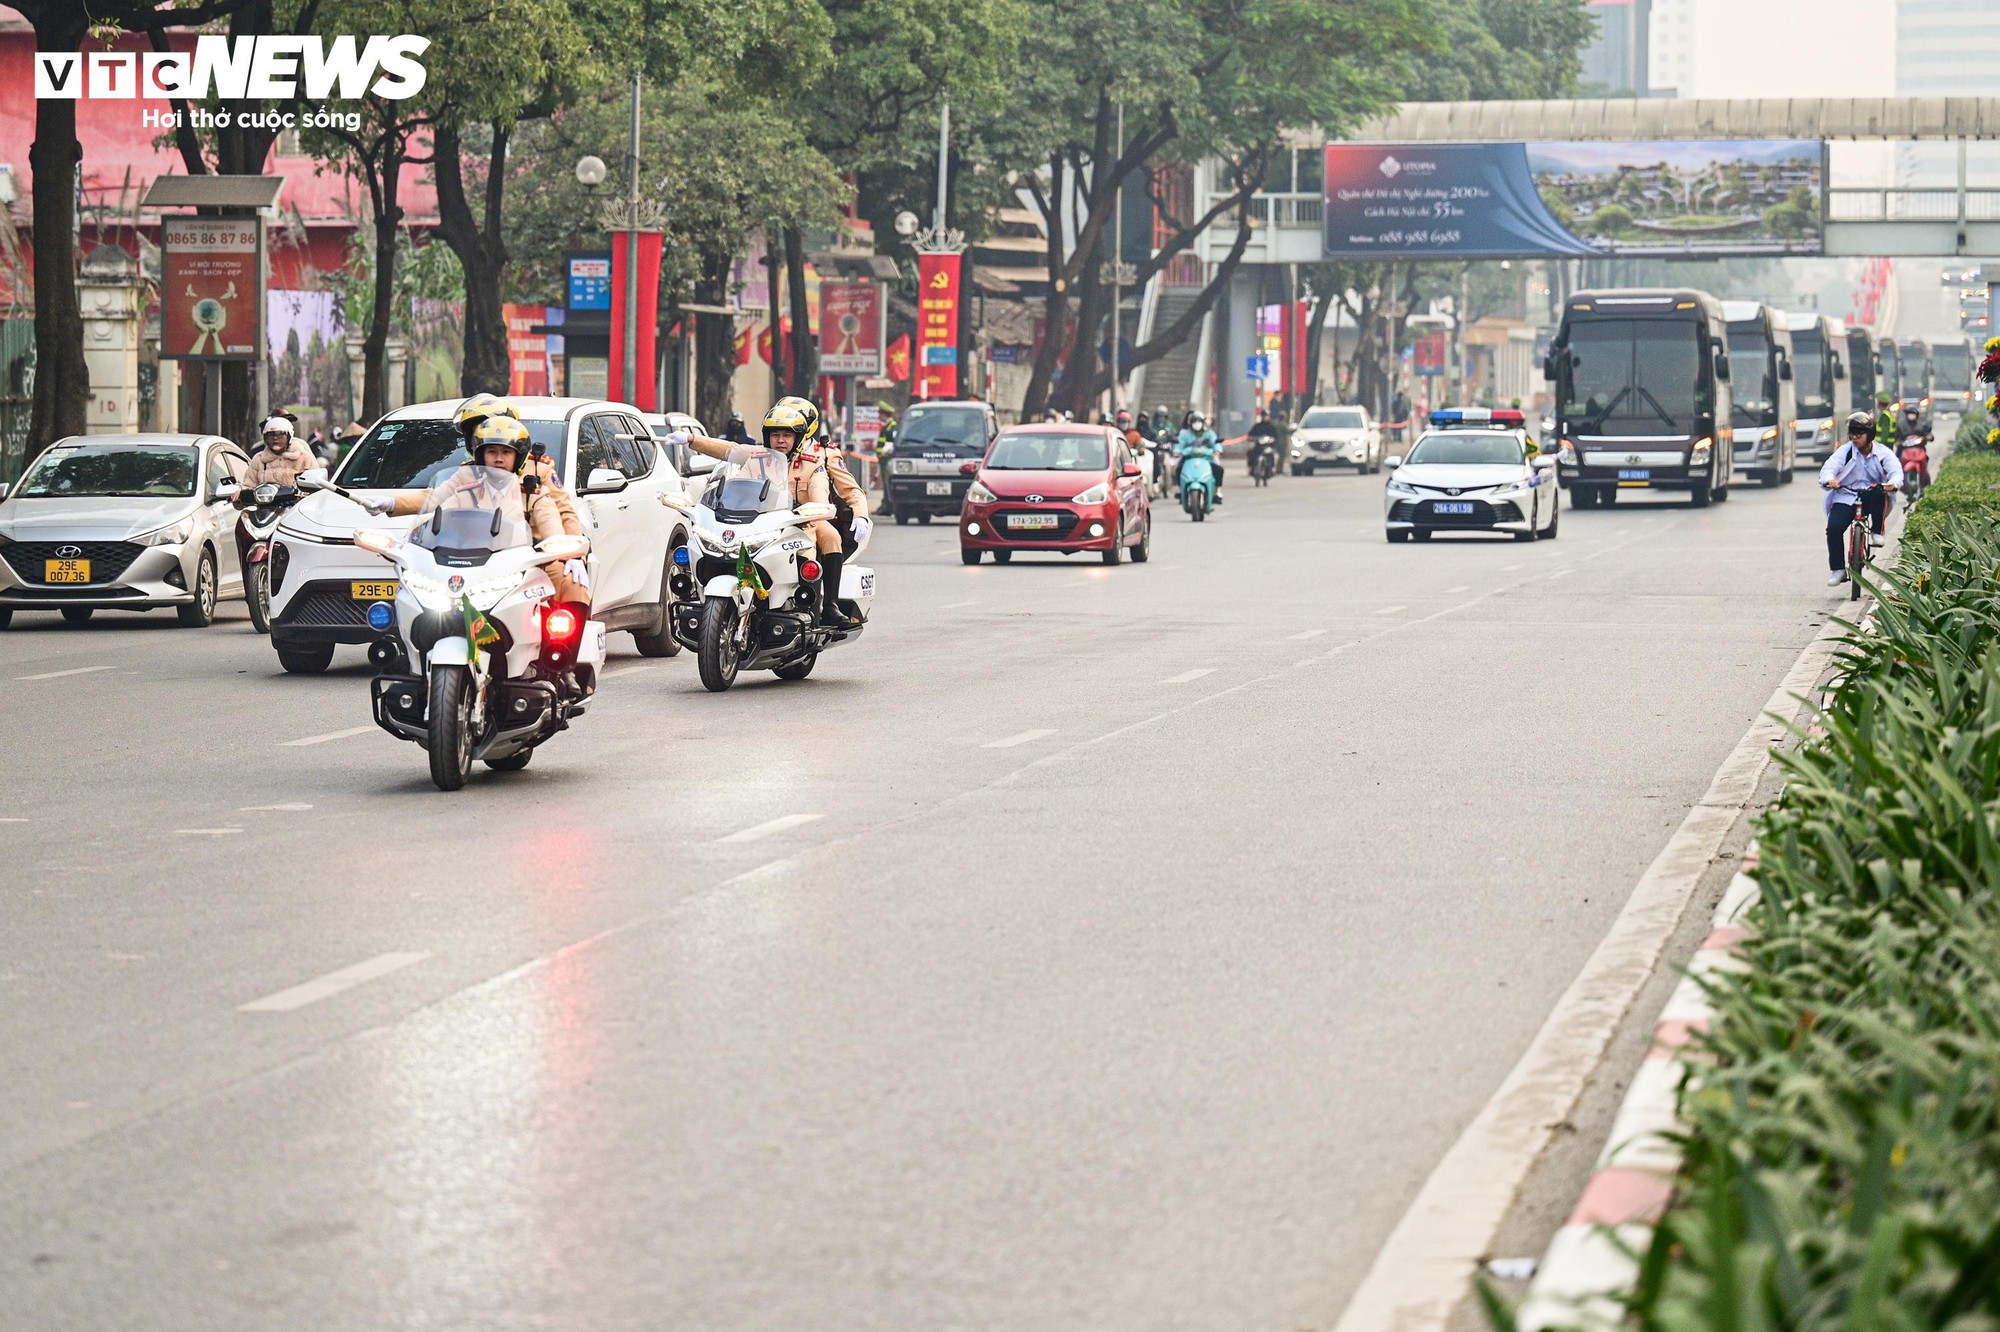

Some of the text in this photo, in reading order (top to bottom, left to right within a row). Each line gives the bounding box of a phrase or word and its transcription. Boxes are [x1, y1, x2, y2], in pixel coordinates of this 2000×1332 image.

[167, 233, 255, 244] 0865 86 87 86
[781, 540, 804, 551] CSGT
[58, 560, 78, 571] 29E
[50, 571, 85, 582] 007.36
[860, 574, 874, 590] CSGT
[358, 584, 394, 597] 29E-0
[523, 586, 547, 599] CSGT
